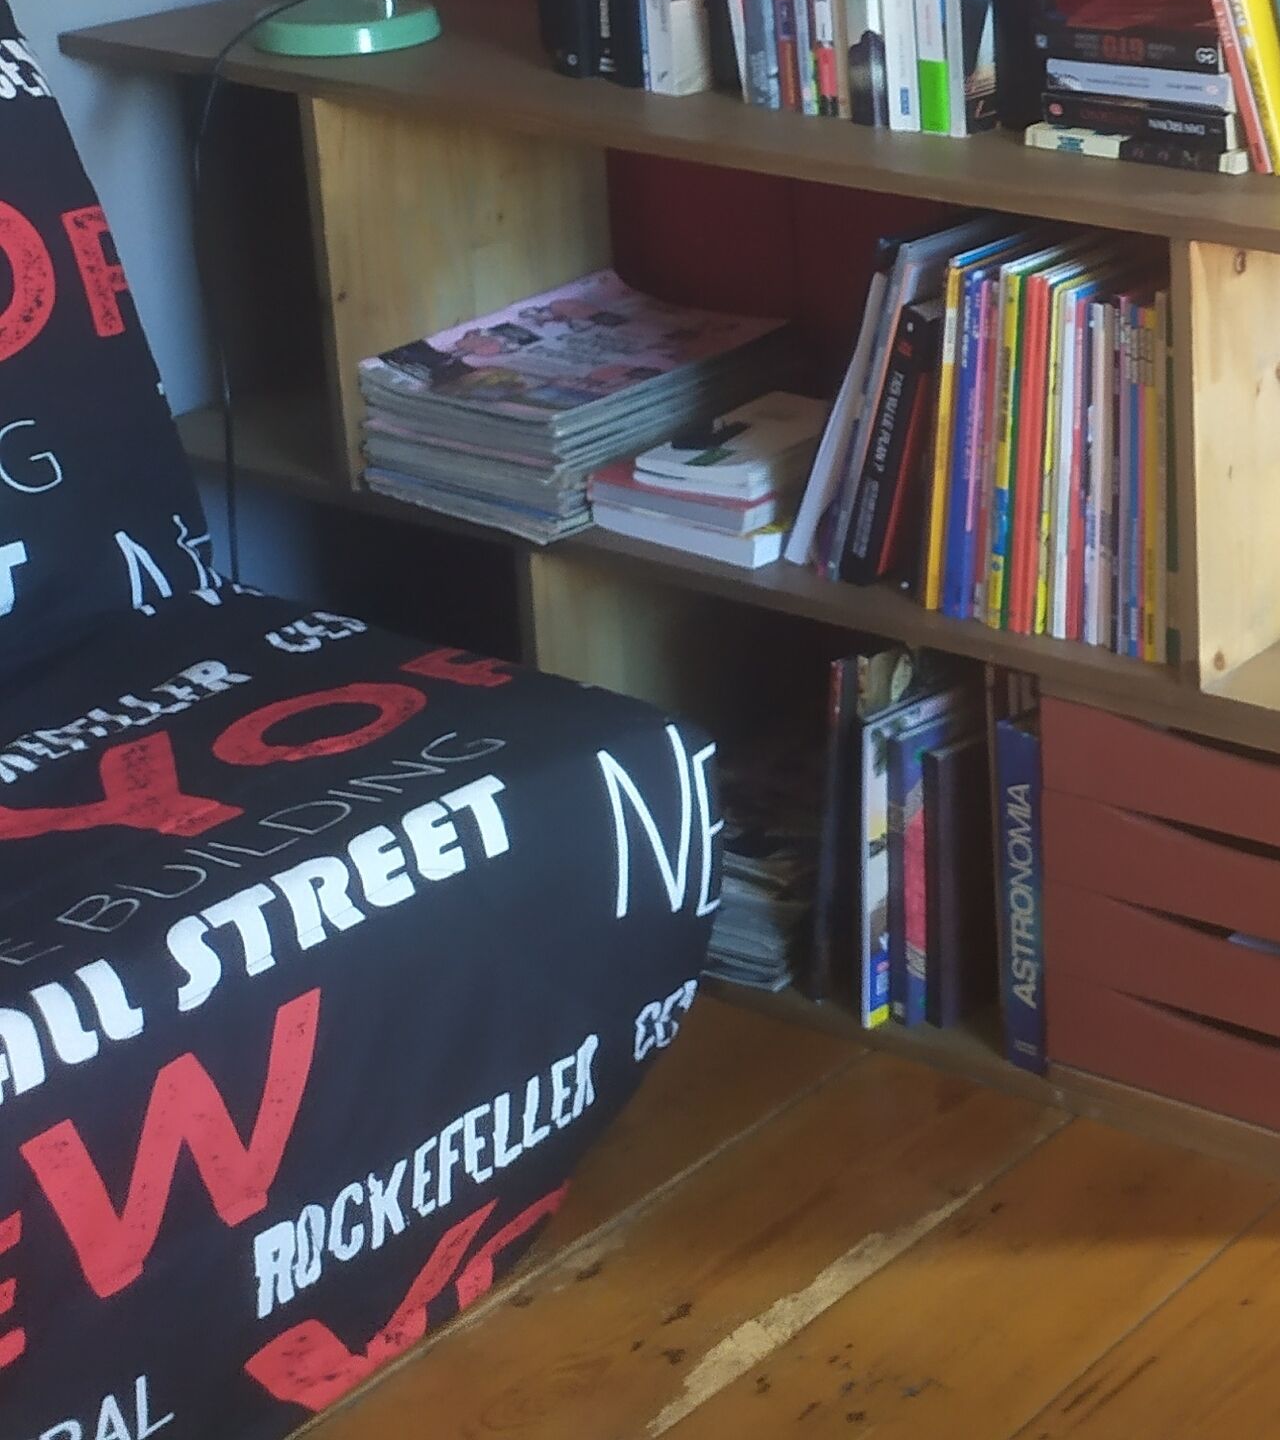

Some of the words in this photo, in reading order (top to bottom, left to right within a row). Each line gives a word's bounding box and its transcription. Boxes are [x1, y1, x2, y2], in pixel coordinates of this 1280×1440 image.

[57, 730, 507, 933] BUILDING
[166, 774, 510, 1014] STREET
[1006, 782, 1040, 1010] ASTRONOMIA
[254, 1032, 601, 1320] ROCKEFELLER
